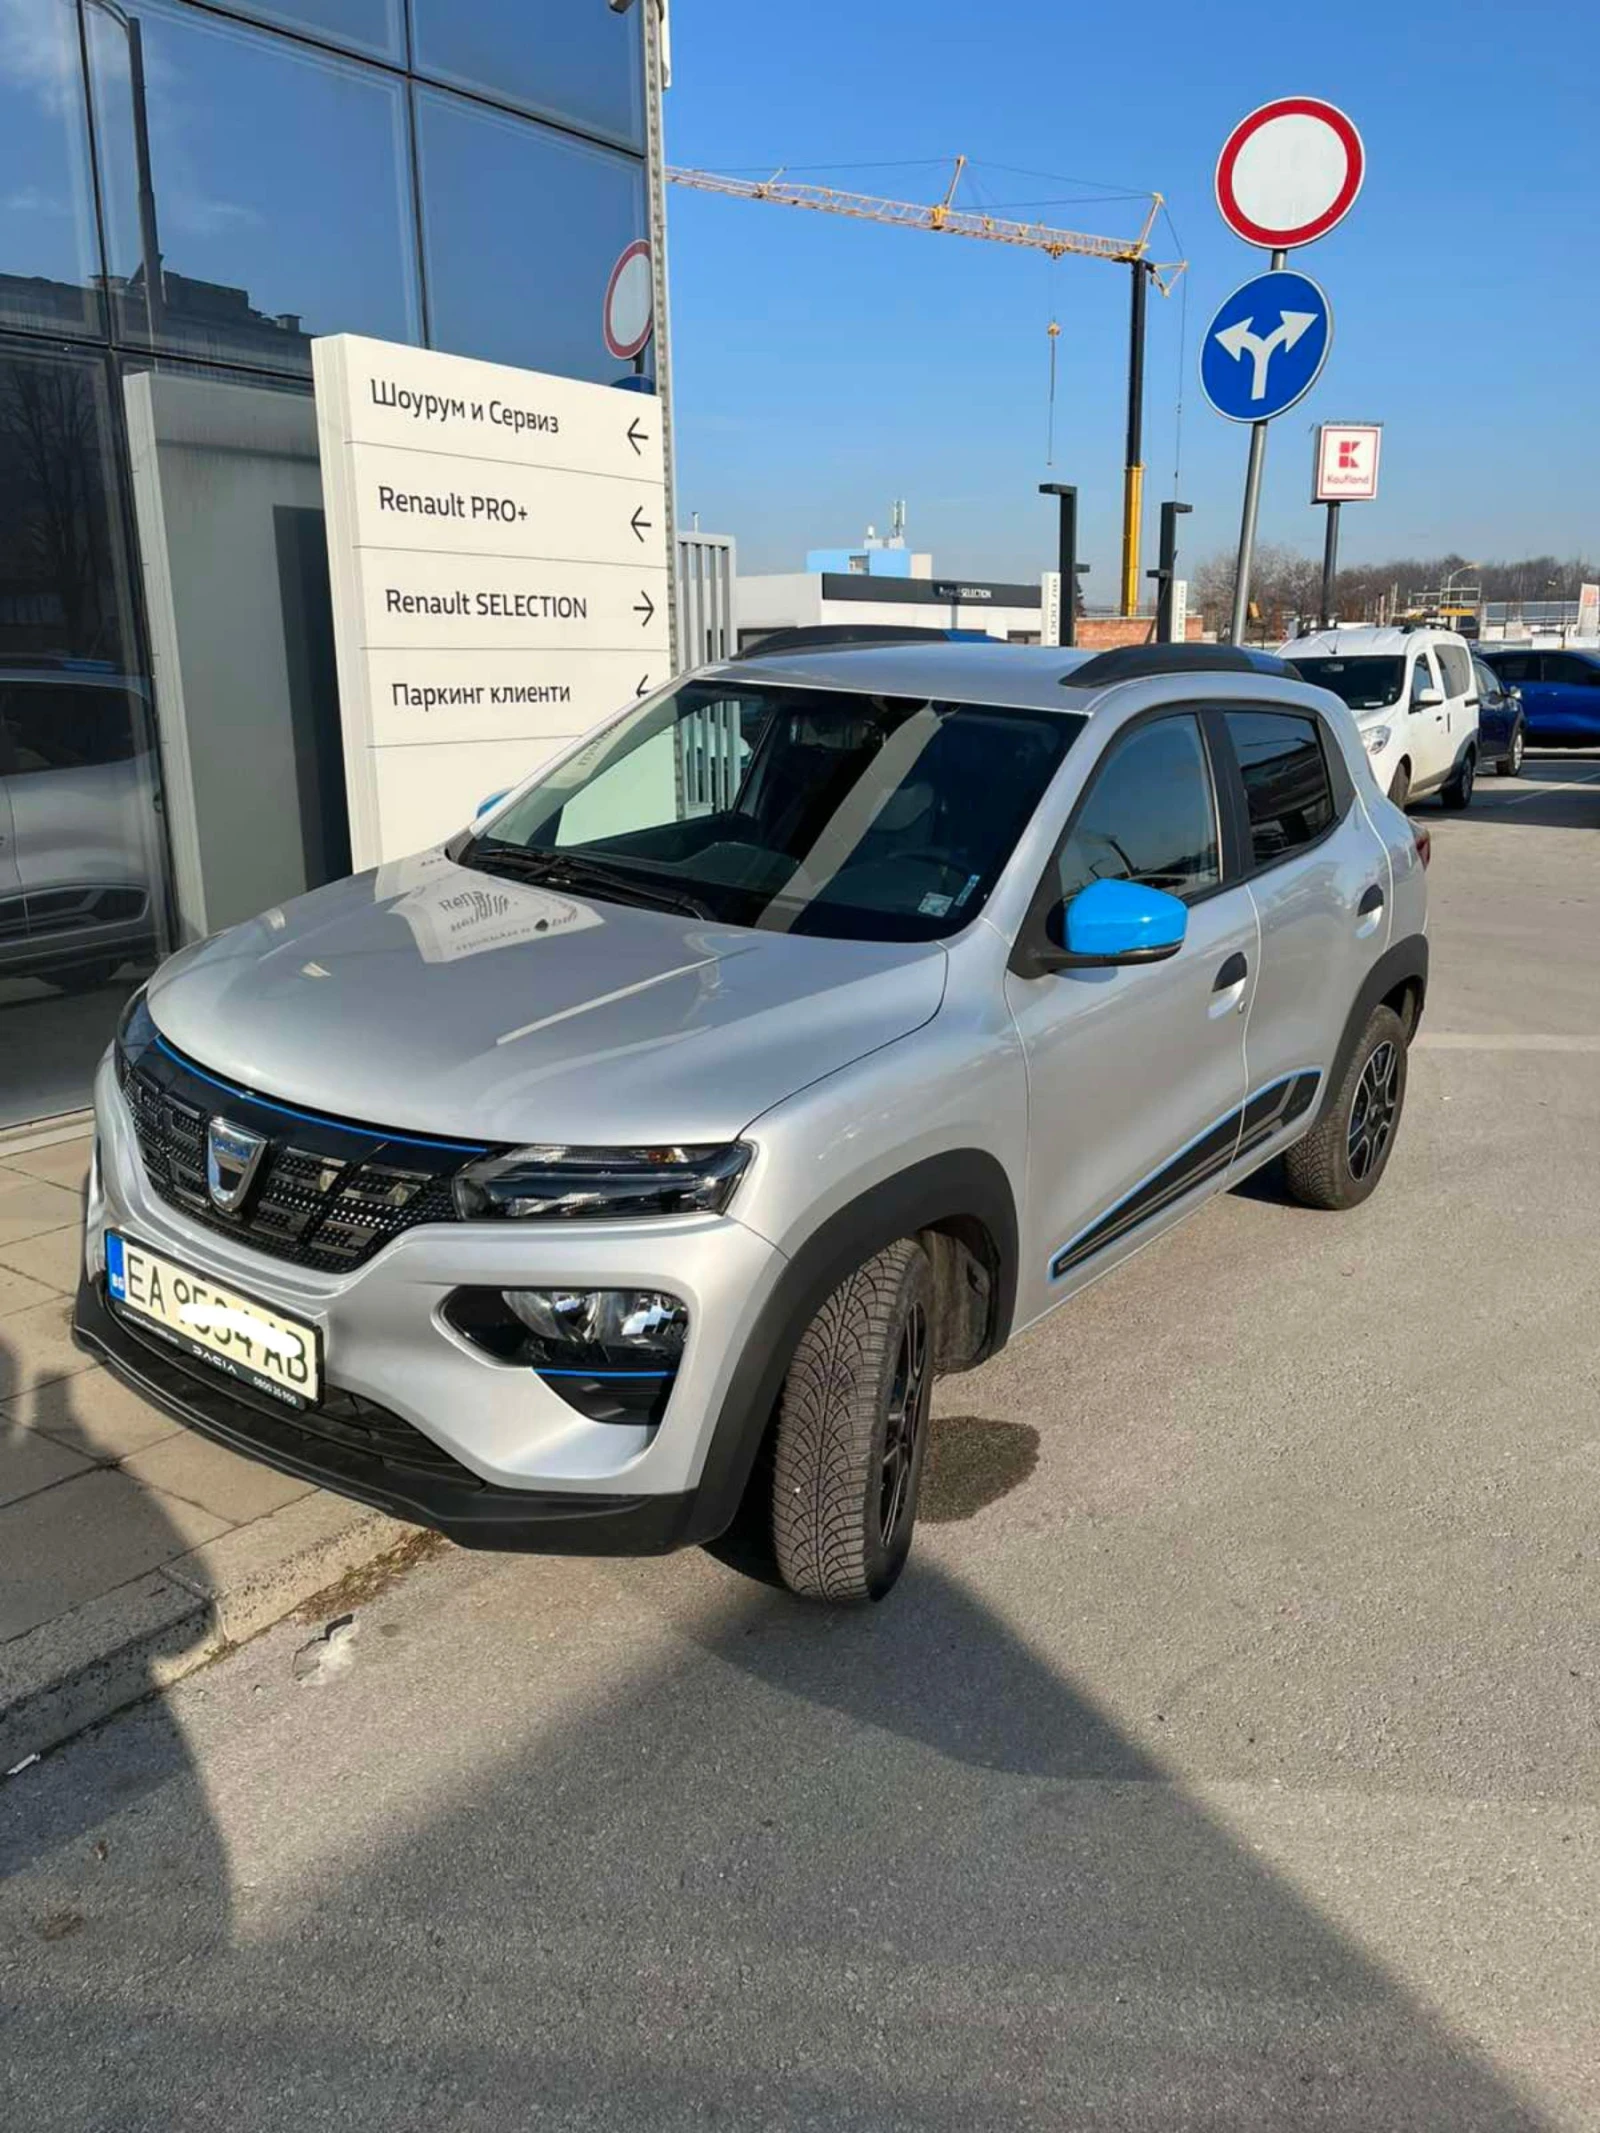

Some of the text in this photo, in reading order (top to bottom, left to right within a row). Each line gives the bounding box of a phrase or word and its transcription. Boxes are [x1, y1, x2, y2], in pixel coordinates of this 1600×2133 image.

[370, 378, 560, 434] Шоурум и Сервиз
[1326, 473, 1369, 485] Kaufland
[378, 485, 528, 522] Renault PRO+
[385, 588, 587, 619] Renault SELECTION
[391, 683, 571, 712] Паркинг клиенти
[127, 1254, 166, 1315] EA
